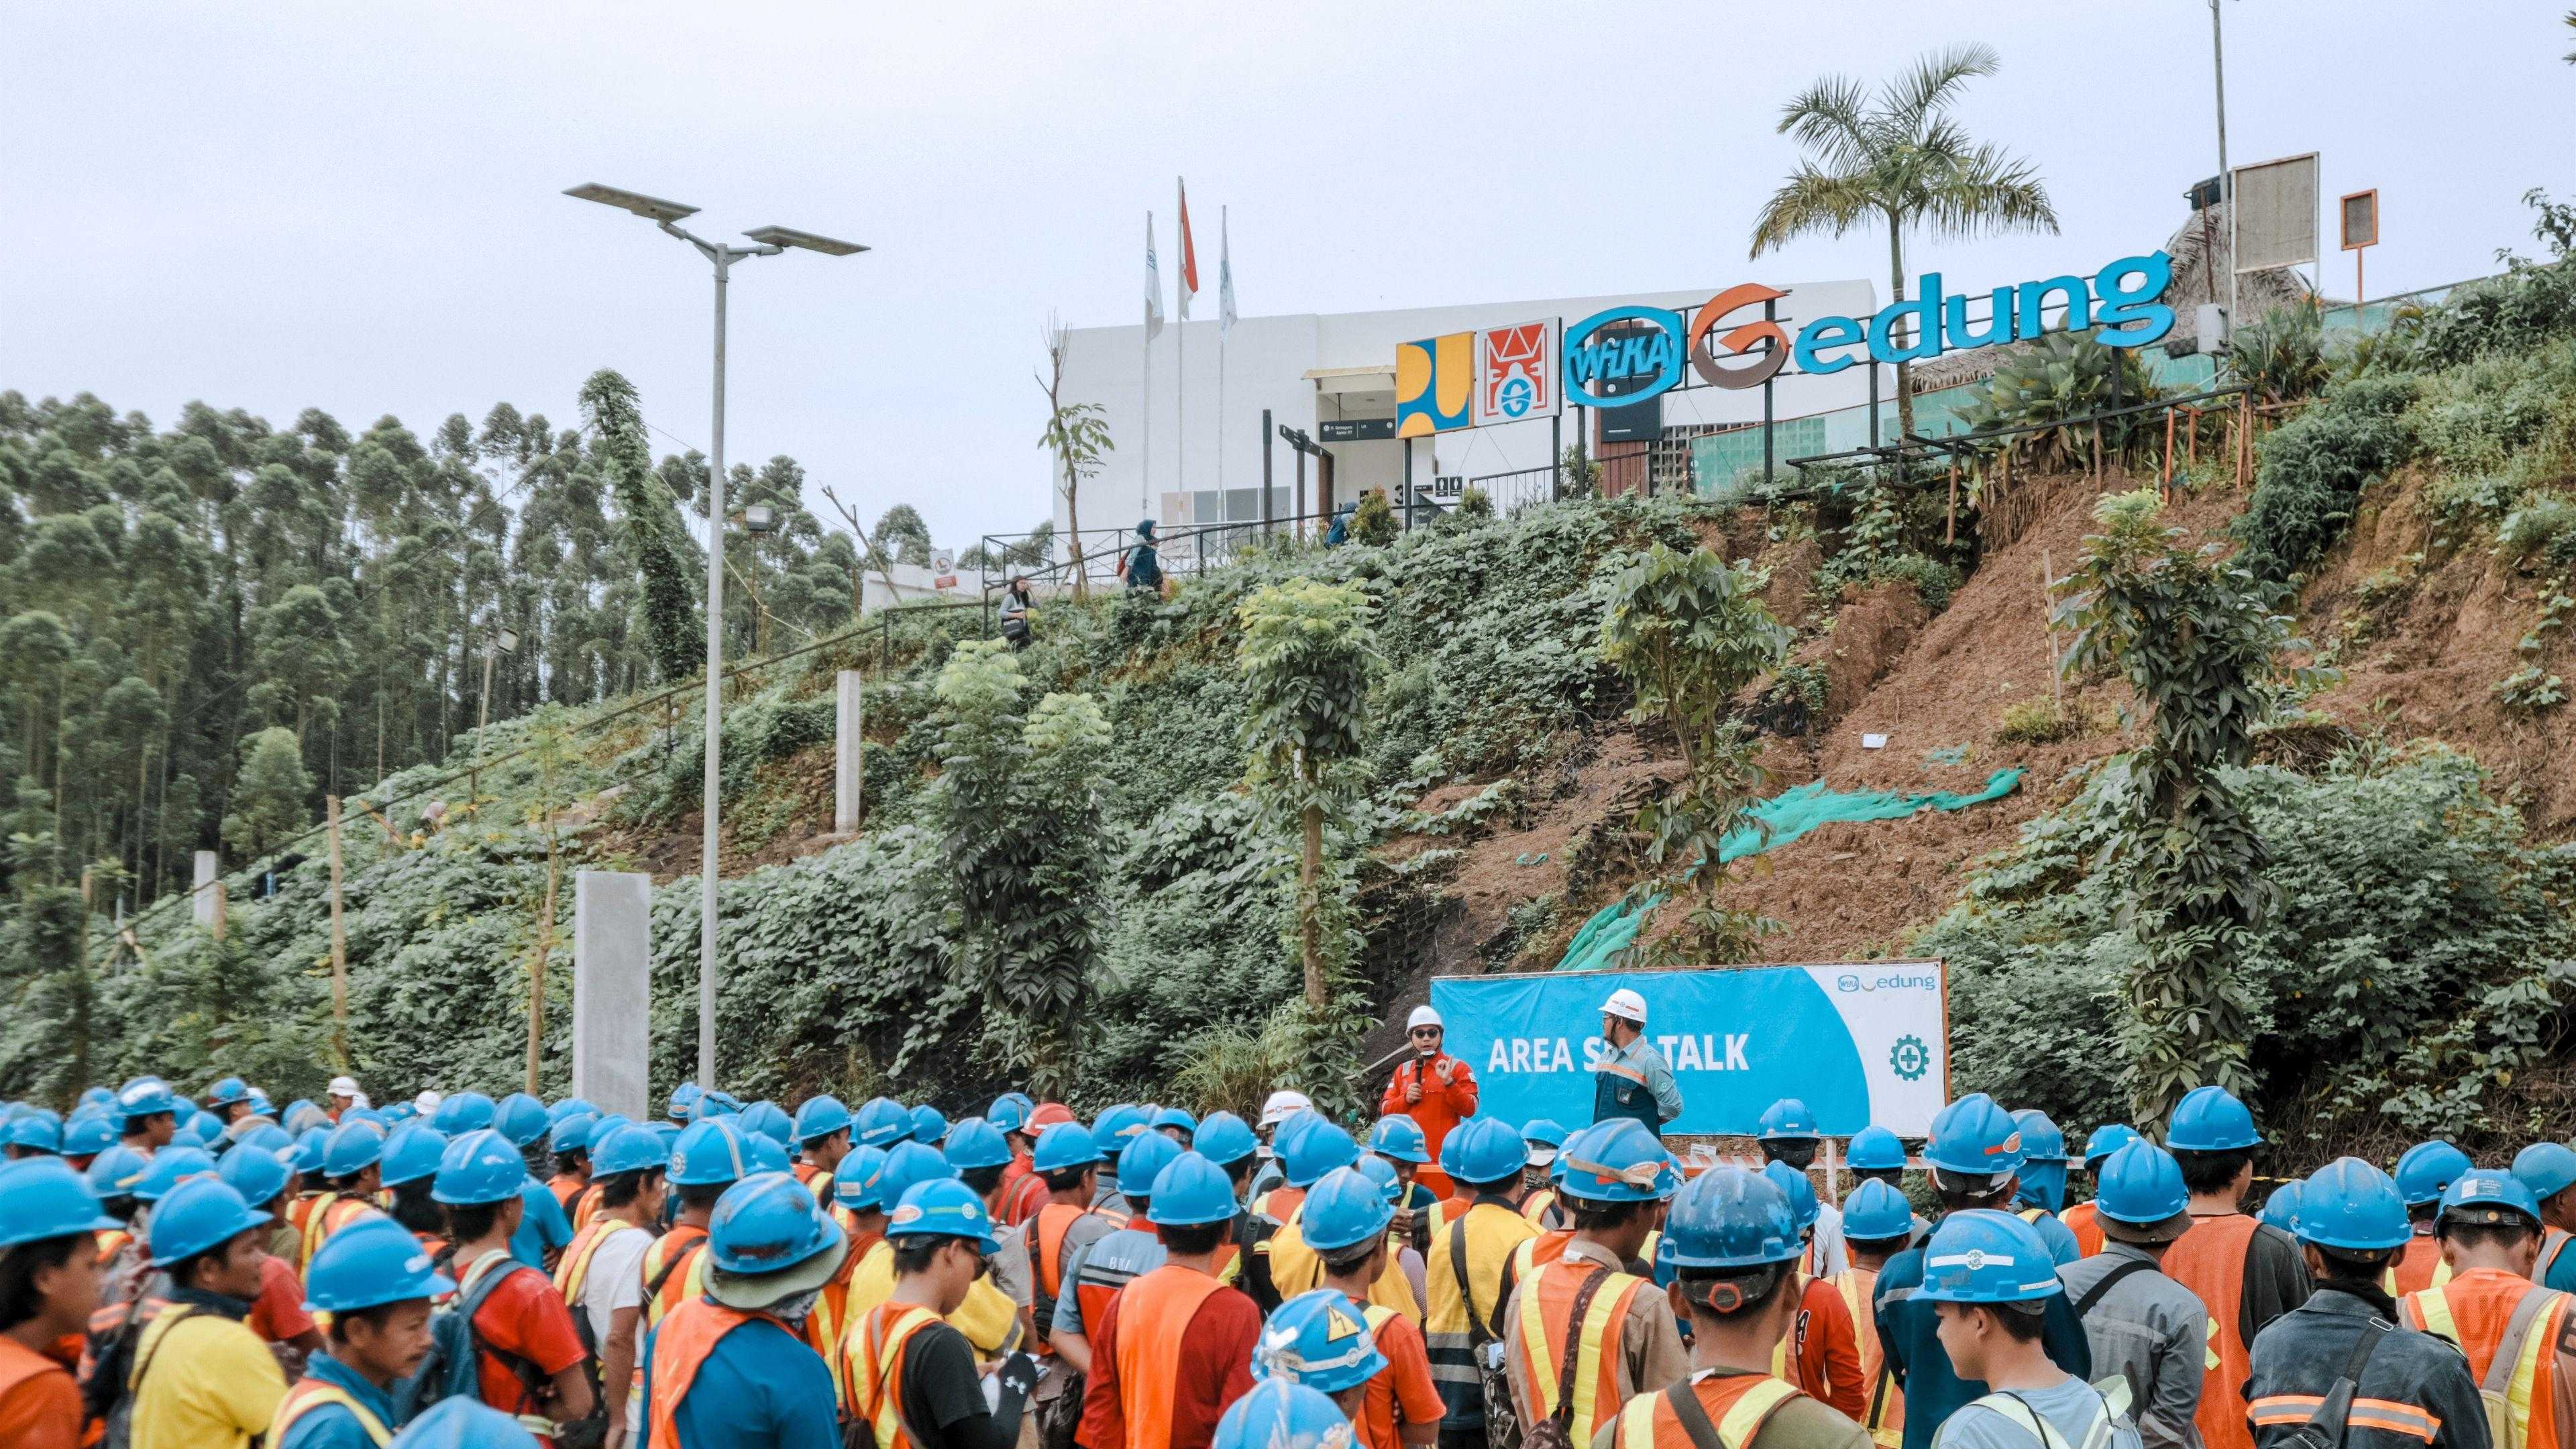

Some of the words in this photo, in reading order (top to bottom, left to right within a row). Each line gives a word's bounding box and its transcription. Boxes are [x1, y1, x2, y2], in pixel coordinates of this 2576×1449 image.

[1690, 250, 2176, 390] Gedung
[1487, 1037, 1575, 1073] AREA
[1657, 1033, 1750, 1071] TALK
